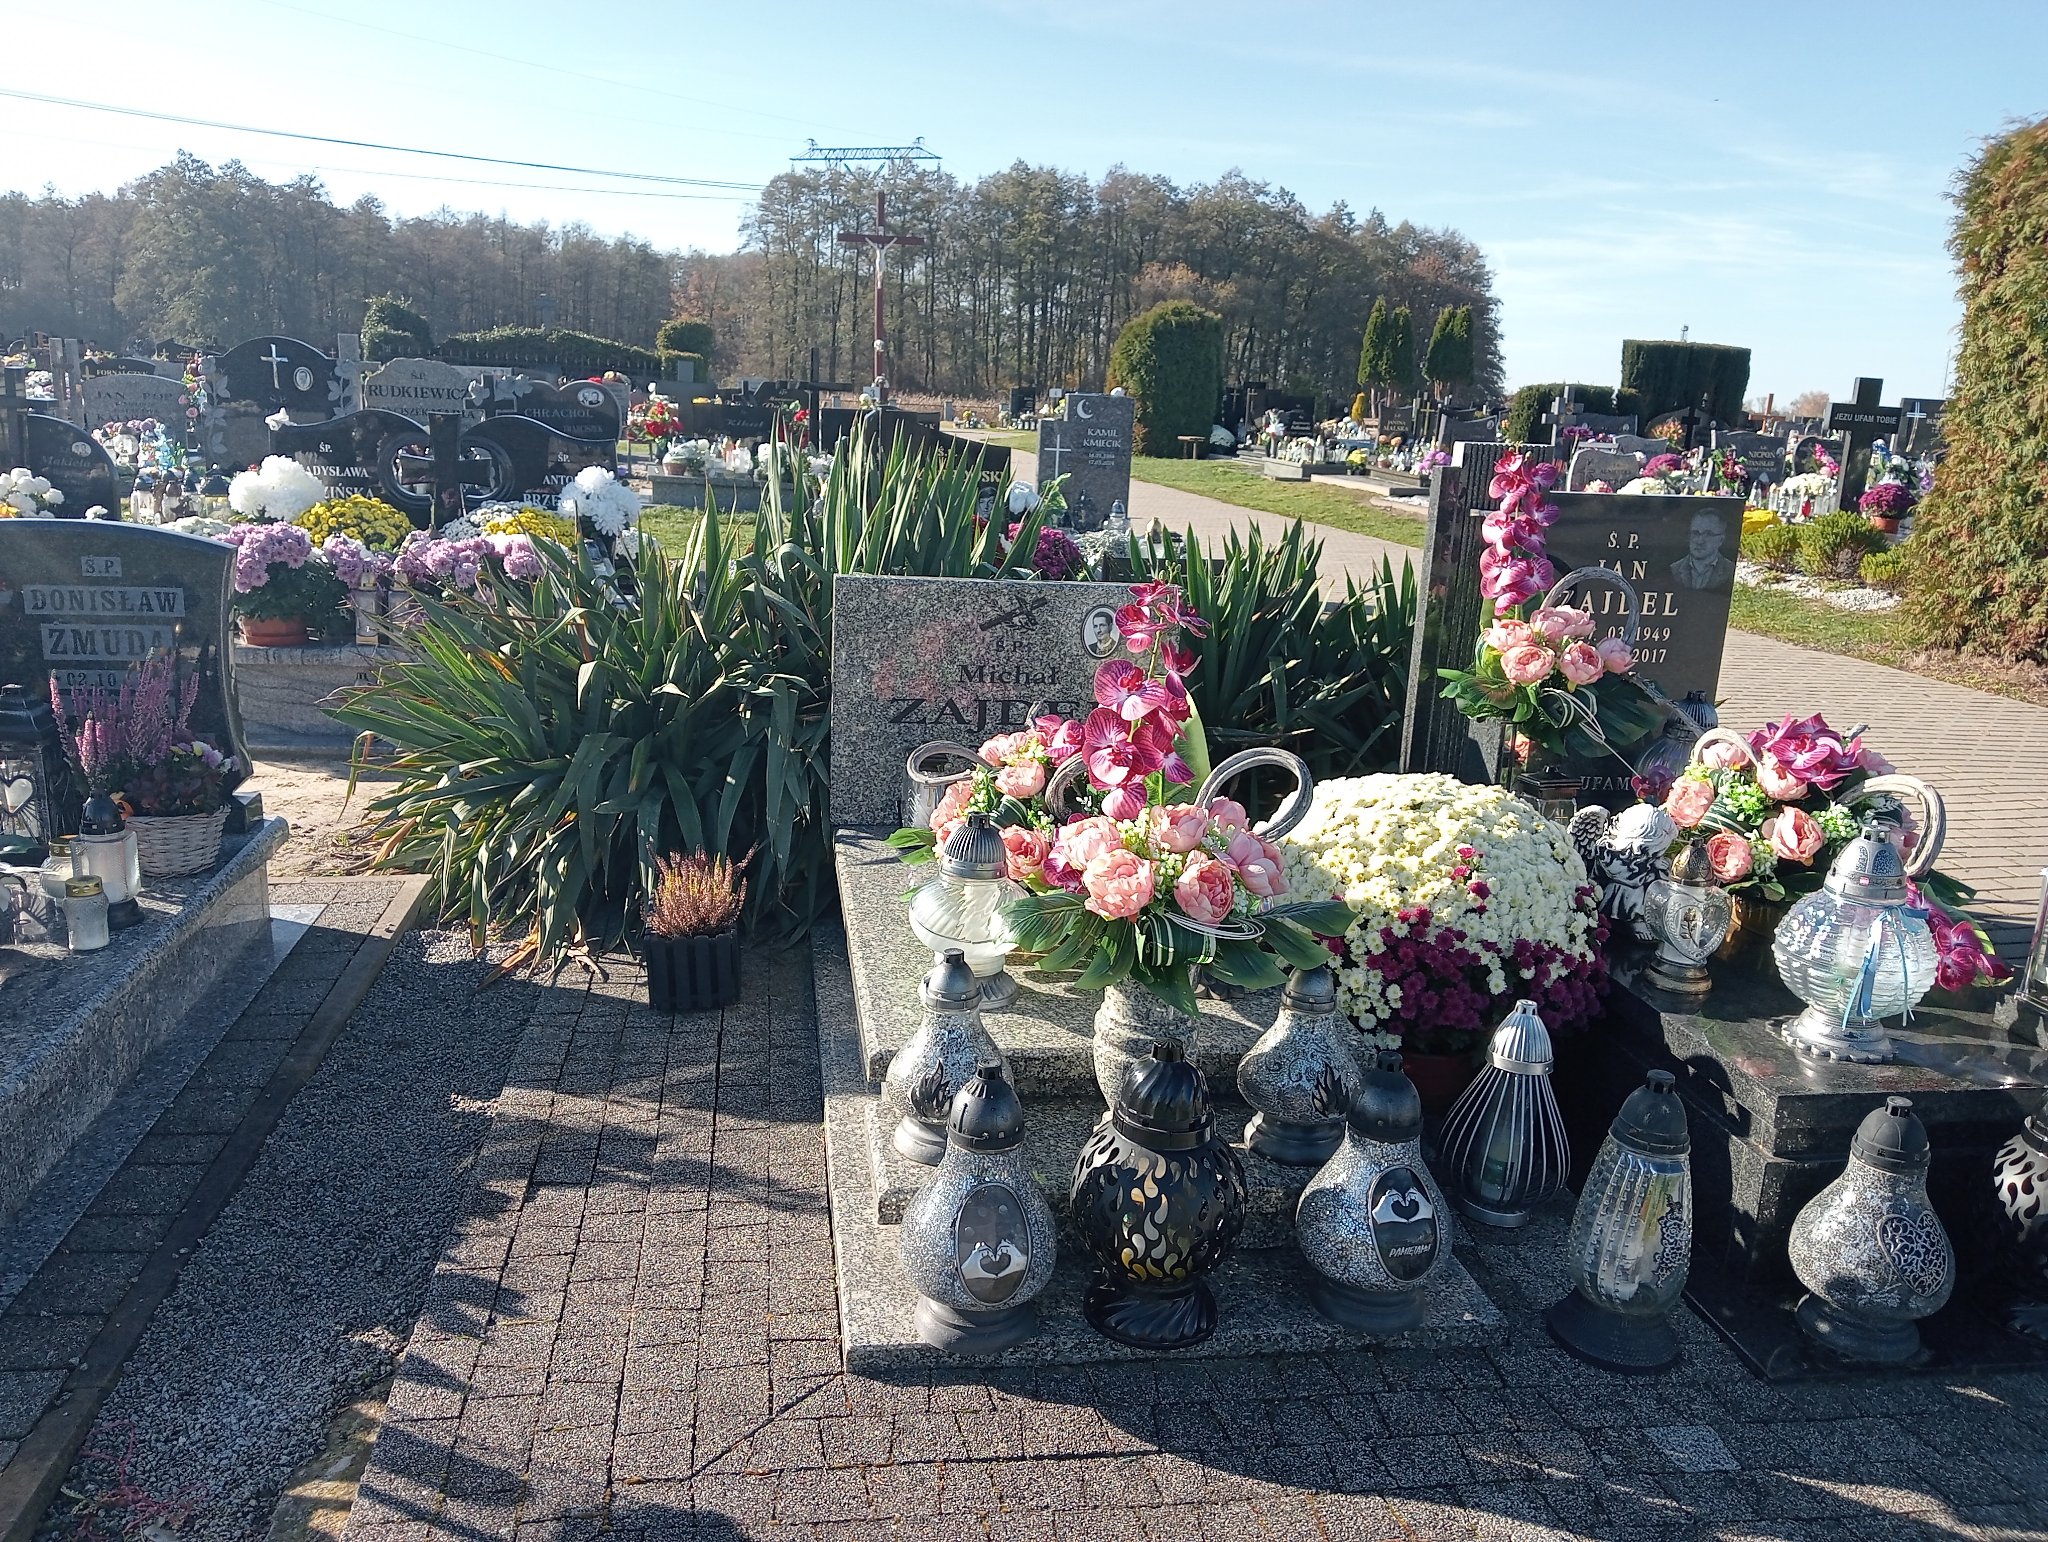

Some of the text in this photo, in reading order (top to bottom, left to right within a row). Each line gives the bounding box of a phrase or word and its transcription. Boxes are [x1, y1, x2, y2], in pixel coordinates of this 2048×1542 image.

[368, 385, 470, 400] RUDKIEWICZ
[1834, 413, 1898, 425] JEZU UFAM TOBIE
[1087, 428, 1119, 437] KAMIL
[542, 474, 576, 486] ANTO
[523, 493, 561, 507] BRZE
[1635, 626, 1671, 642] 1949
[1631, 648, 1667, 663] 2017
[959, 664, 1059, 685] Michał
[887, 697, 1099, 734] ZAJDE
[1579, 775, 1631, 791] UFAM
